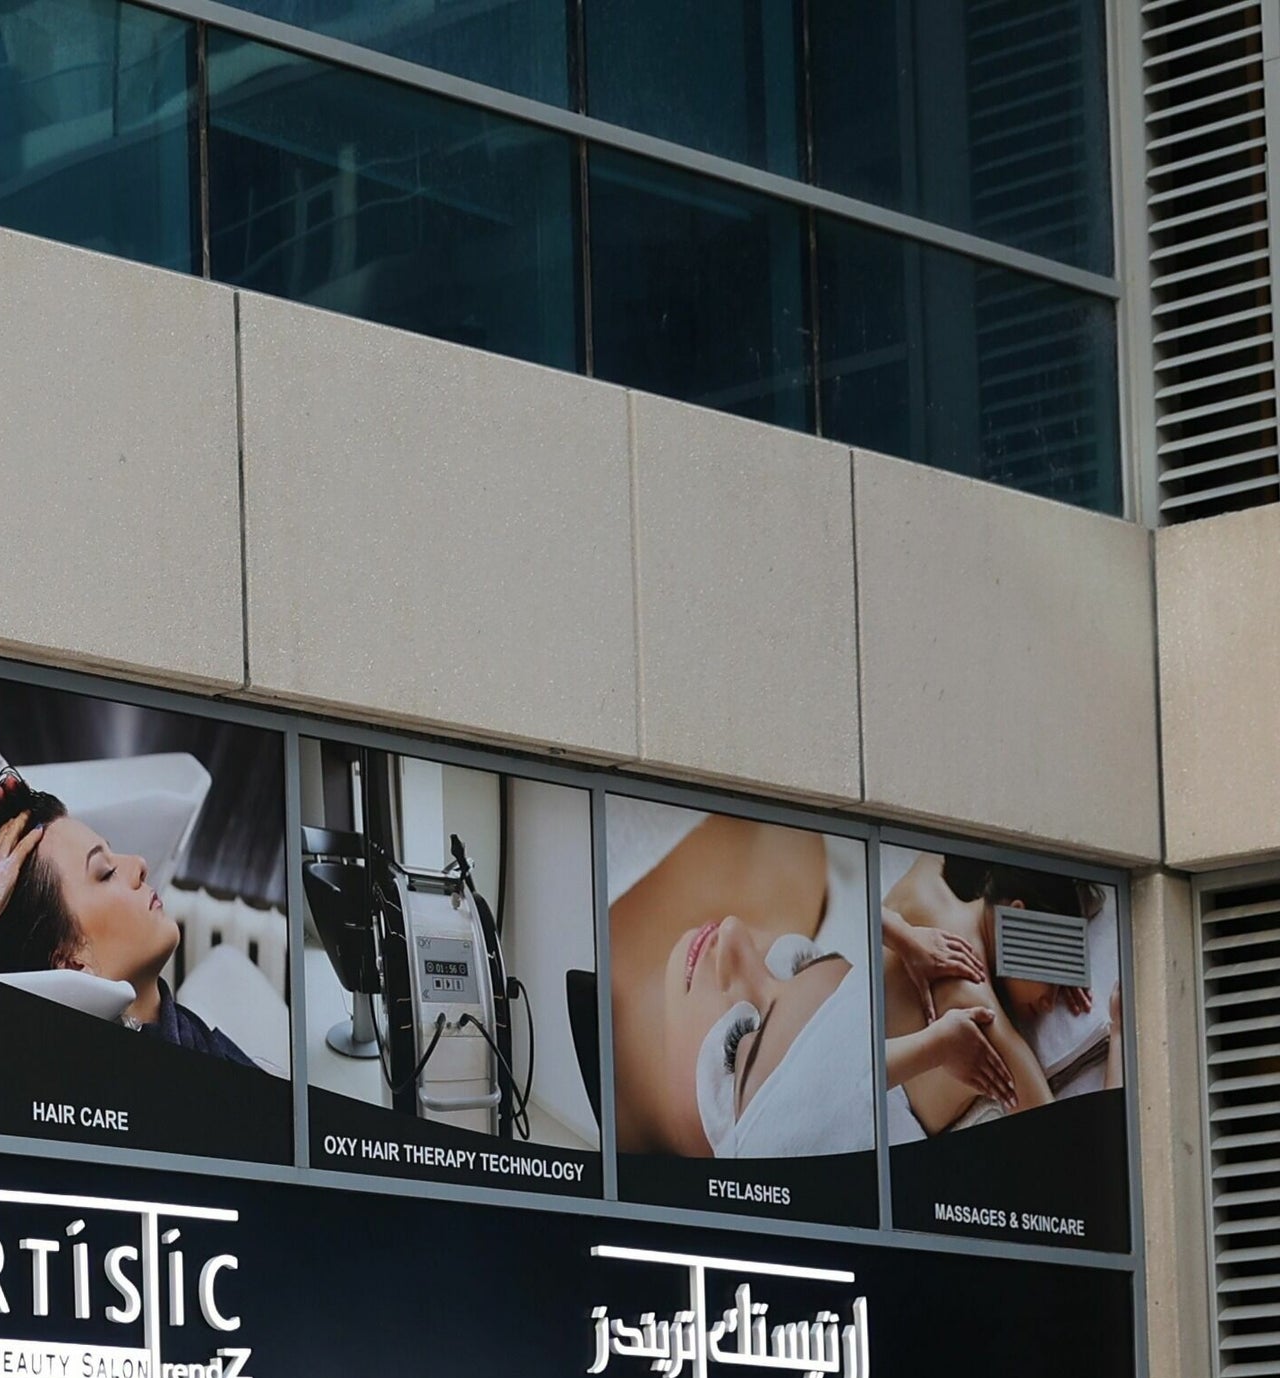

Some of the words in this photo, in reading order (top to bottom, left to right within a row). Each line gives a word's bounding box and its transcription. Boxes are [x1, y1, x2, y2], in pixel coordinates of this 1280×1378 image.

[34, 1102, 75, 1124] HAIR
[81, 1108, 128, 1130] CARE
[324, 1136, 357, 1156] OXY
[362, 1140, 399, 1161] HAIR
[404, 1144, 476, 1169] THERAPY
[480, 1153, 584, 1181] TECHNOLOGY
[709, 1179, 790, 1204] EYELASHES
[935, 1203, 1006, 1227] MASSAGES
[1010, 1212, 1018, 1228] &
[1022, 1214, 1084, 1236] SKINCARE
